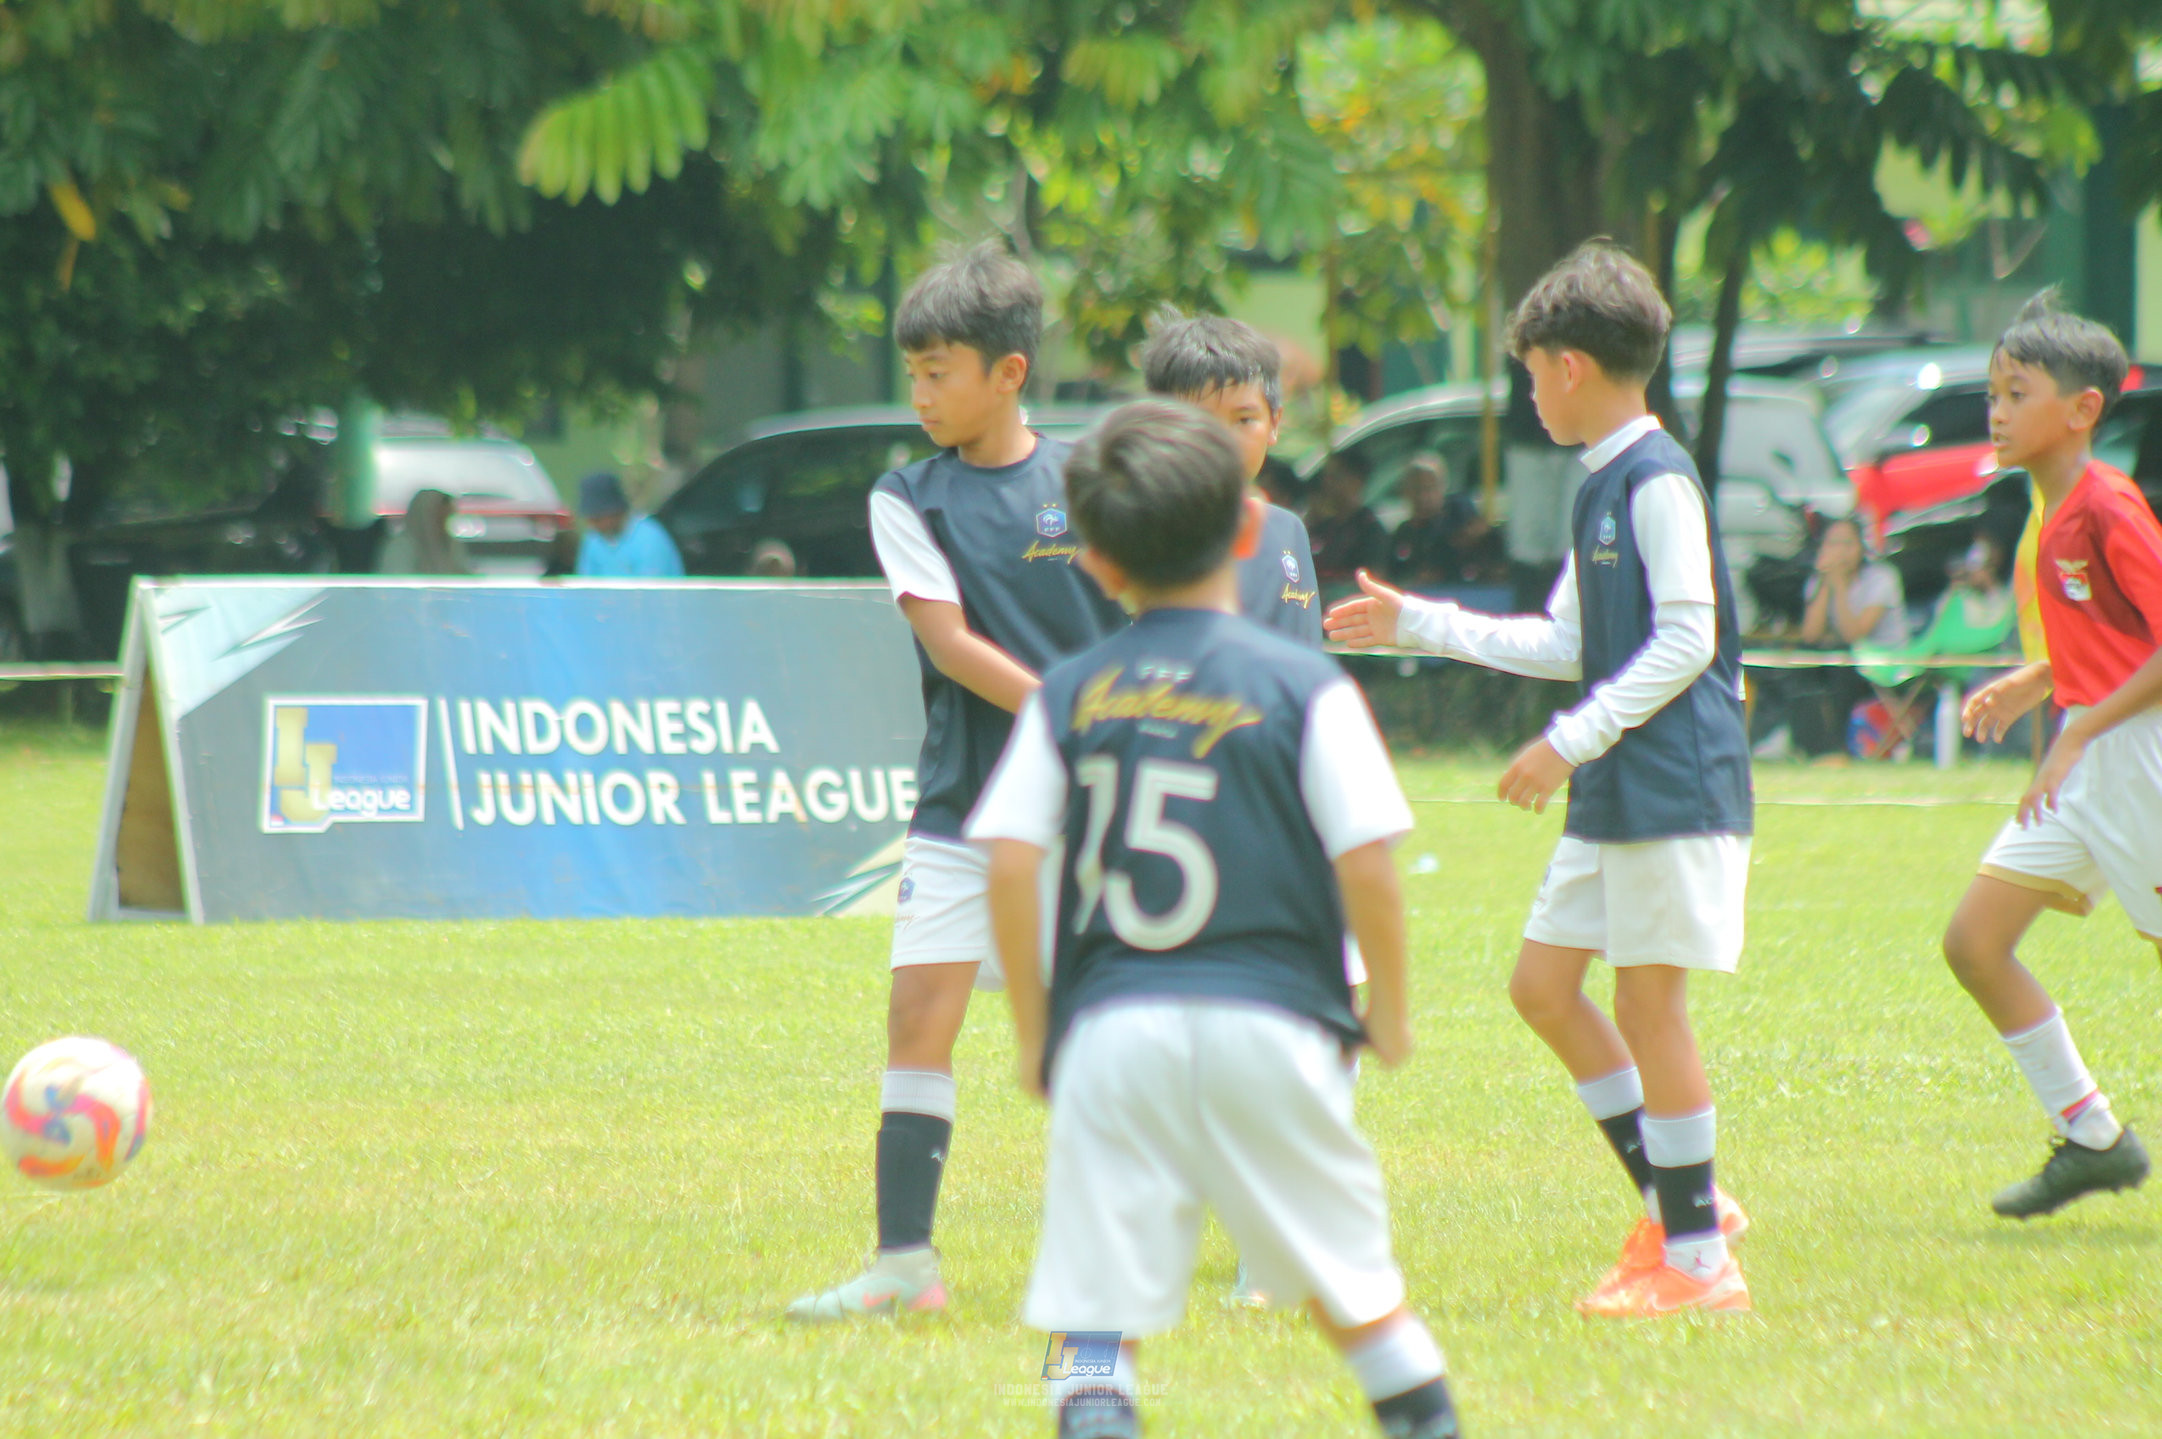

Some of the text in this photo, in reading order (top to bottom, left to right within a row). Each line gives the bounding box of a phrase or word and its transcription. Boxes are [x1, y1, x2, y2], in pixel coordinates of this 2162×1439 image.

[459, 699, 780, 755] INDONESIA
[311, 779, 411, 818] League
[470, 768, 917, 827] JUNIOR LEAGUE
[1073, 756, 1219, 951] 15
